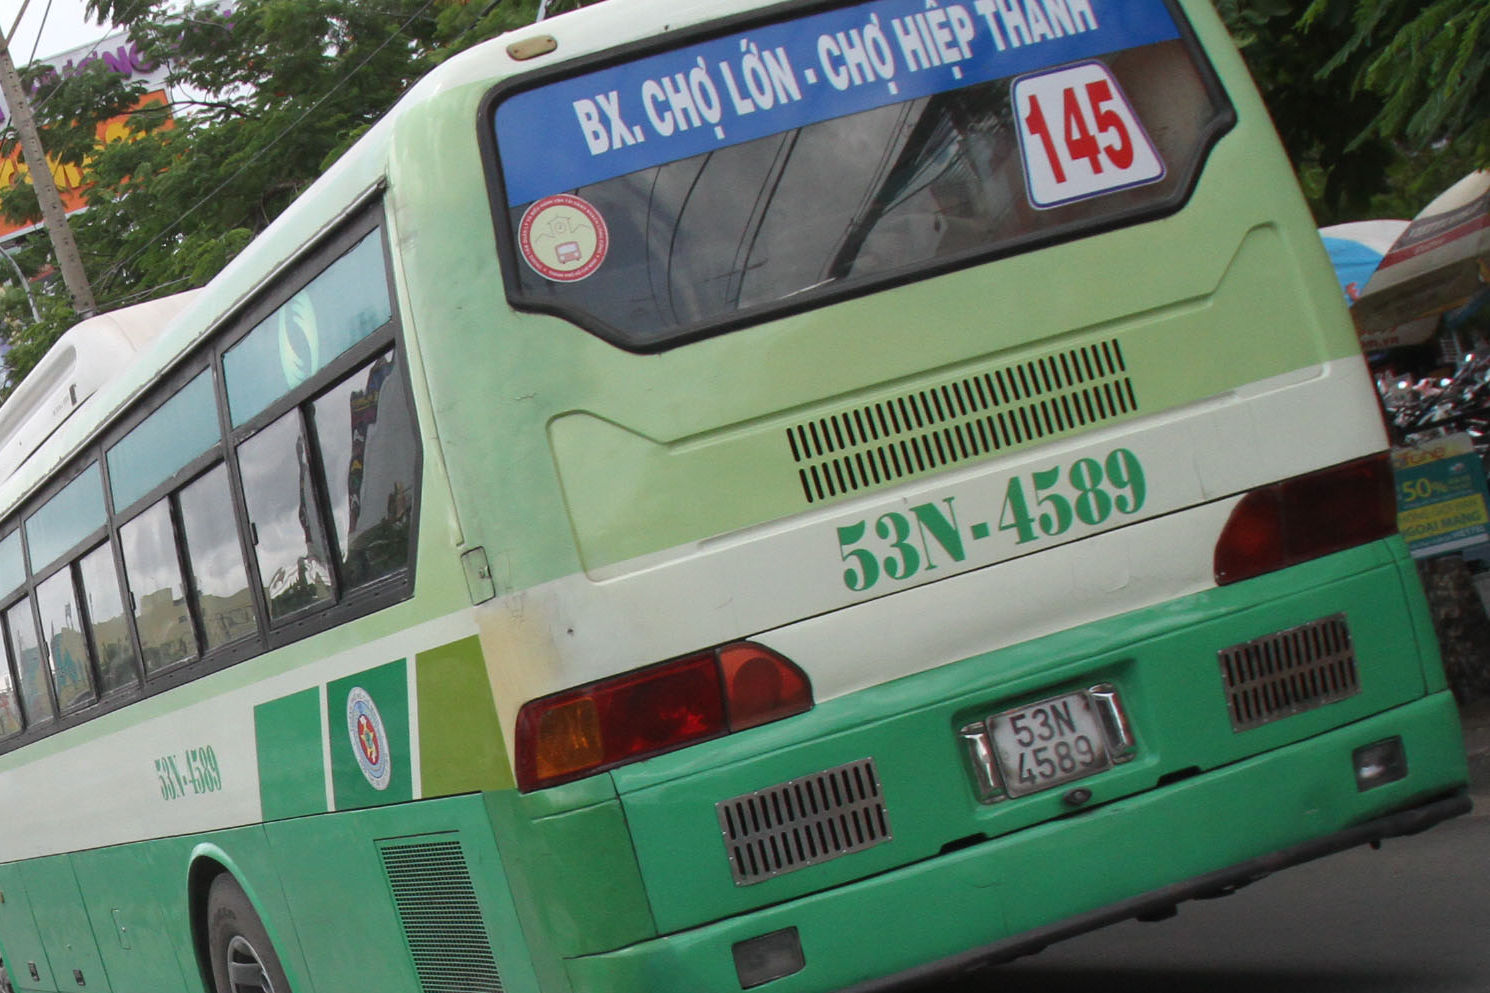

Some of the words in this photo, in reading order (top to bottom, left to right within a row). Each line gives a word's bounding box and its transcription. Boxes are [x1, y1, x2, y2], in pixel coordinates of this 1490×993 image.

[573, 90, 645, 156] BX.
[641, 55, 725, 140] CHỢ
[719, 38, 802, 116] LỚN
[817, 12, 898, 95] CHỢ
[892, 0, 976, 80] HIỆP
[1025, 79, 1134, 184] 145
[837, 448, 1147, 592] 53N-4589
[1009, 701, 1077, 747] 53N
[1019, 735, 1095, 784] 4589
[154, 744, 222, 801] 53N-4589
